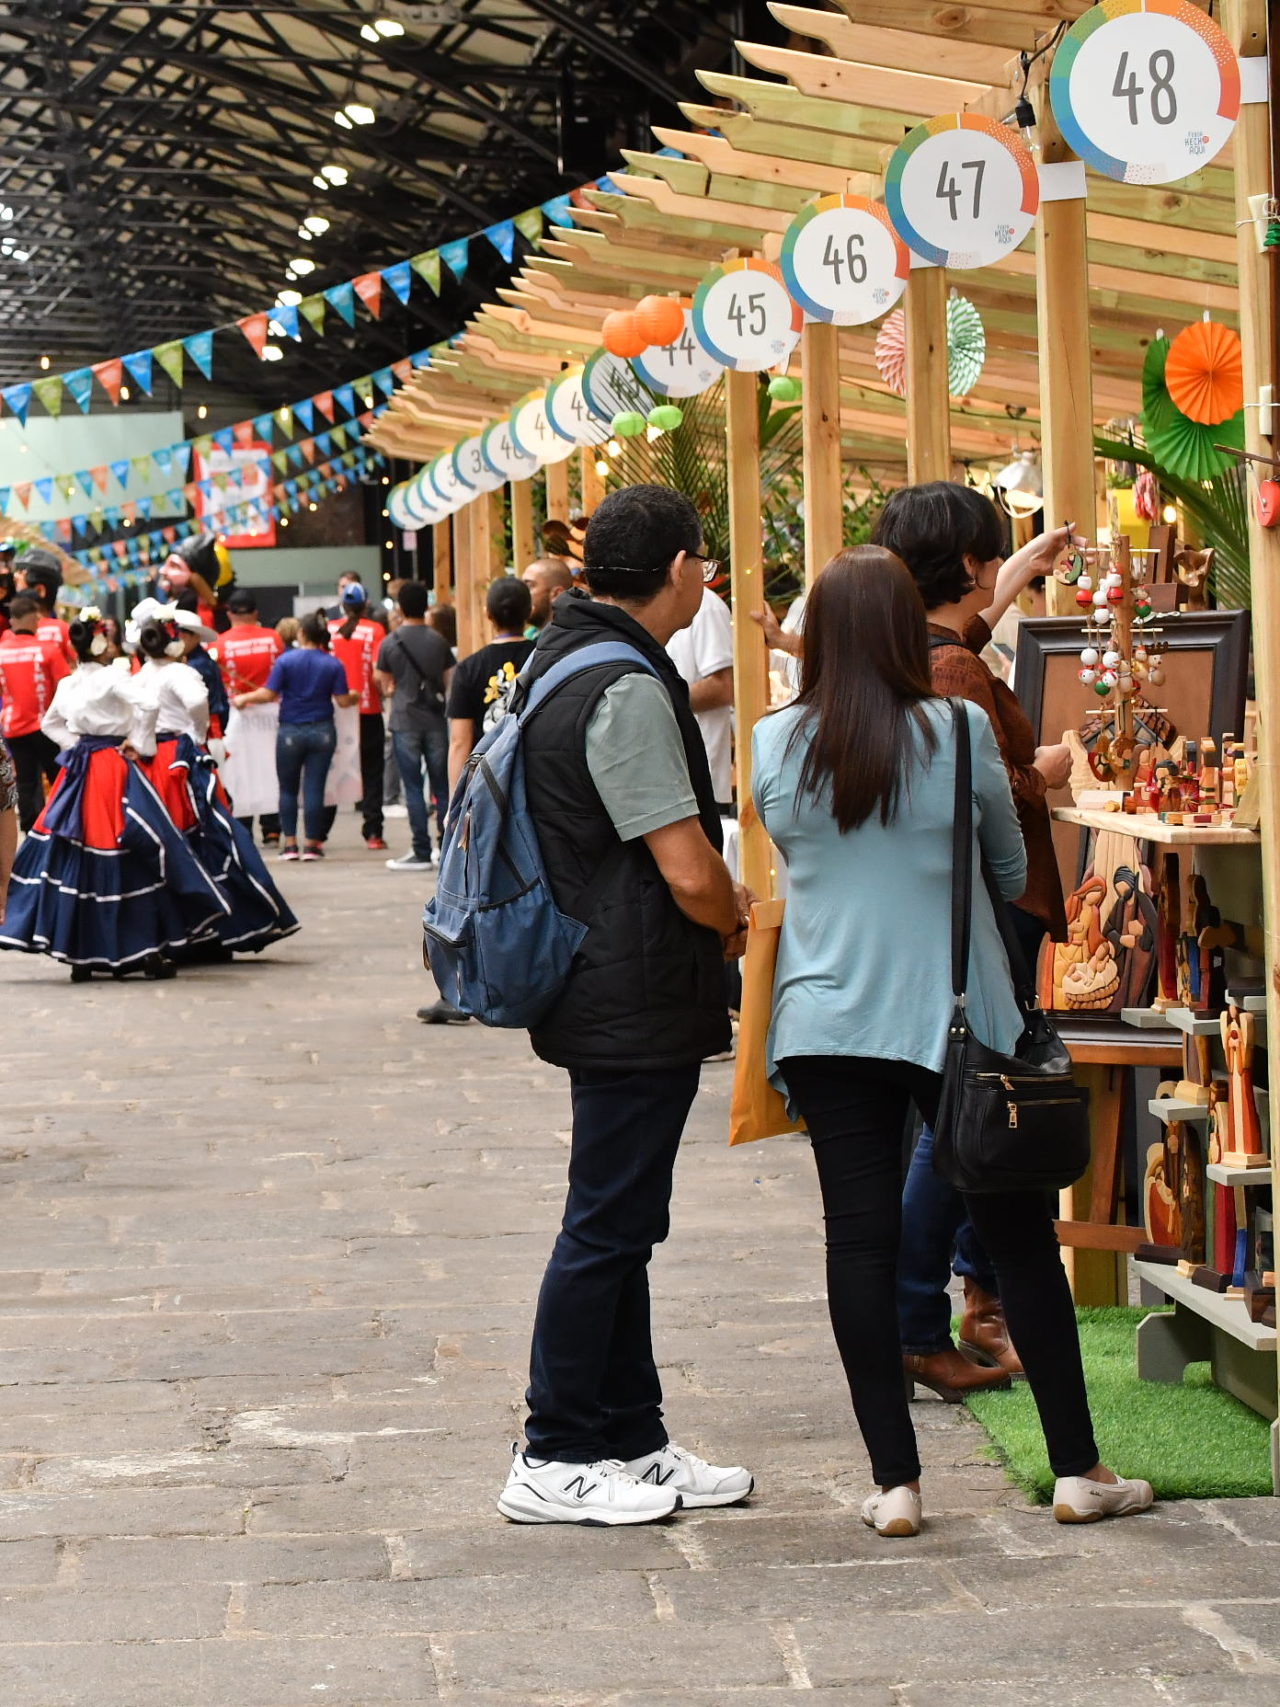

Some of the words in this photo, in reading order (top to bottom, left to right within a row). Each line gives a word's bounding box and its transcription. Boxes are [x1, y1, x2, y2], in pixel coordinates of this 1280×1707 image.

[1112, 49, 1177, 125] 48
[936, 160, 986, 221] 47
[822, 234, 867, 285] 46
[727, 292, 766, 337] 45
[661, 327, 696, 367] 44
